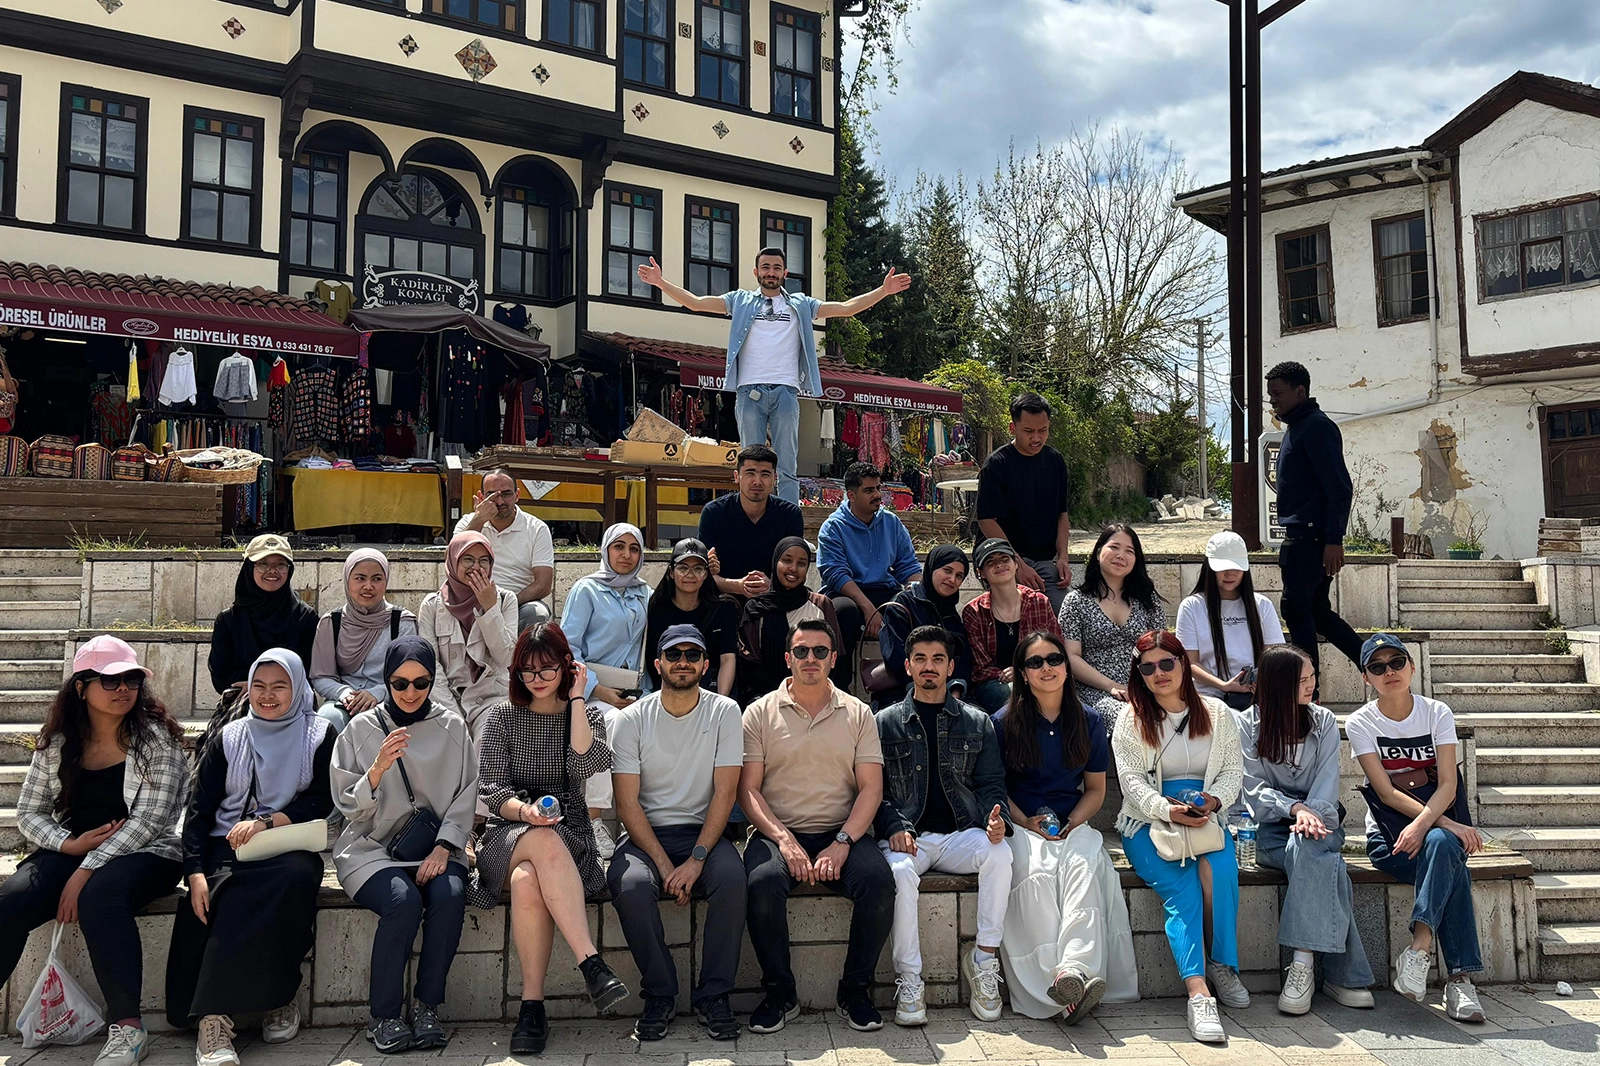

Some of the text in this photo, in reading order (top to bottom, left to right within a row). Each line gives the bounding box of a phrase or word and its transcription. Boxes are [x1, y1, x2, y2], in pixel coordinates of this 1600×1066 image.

[390, 277, 453, 294] KADİRLER
[397, 288, 446, 302] KONAĞI
[48, 308, 107, 332] ÜRÜNLER
[173, 326, 335, 354] HEDİYELİK EŞYA 0 533 431 76 67
[697, 374, 715, 388] NUR
[853, 392, 892, 406] HEDİYELİK
[893, 397, 912, 409] EŞYA
